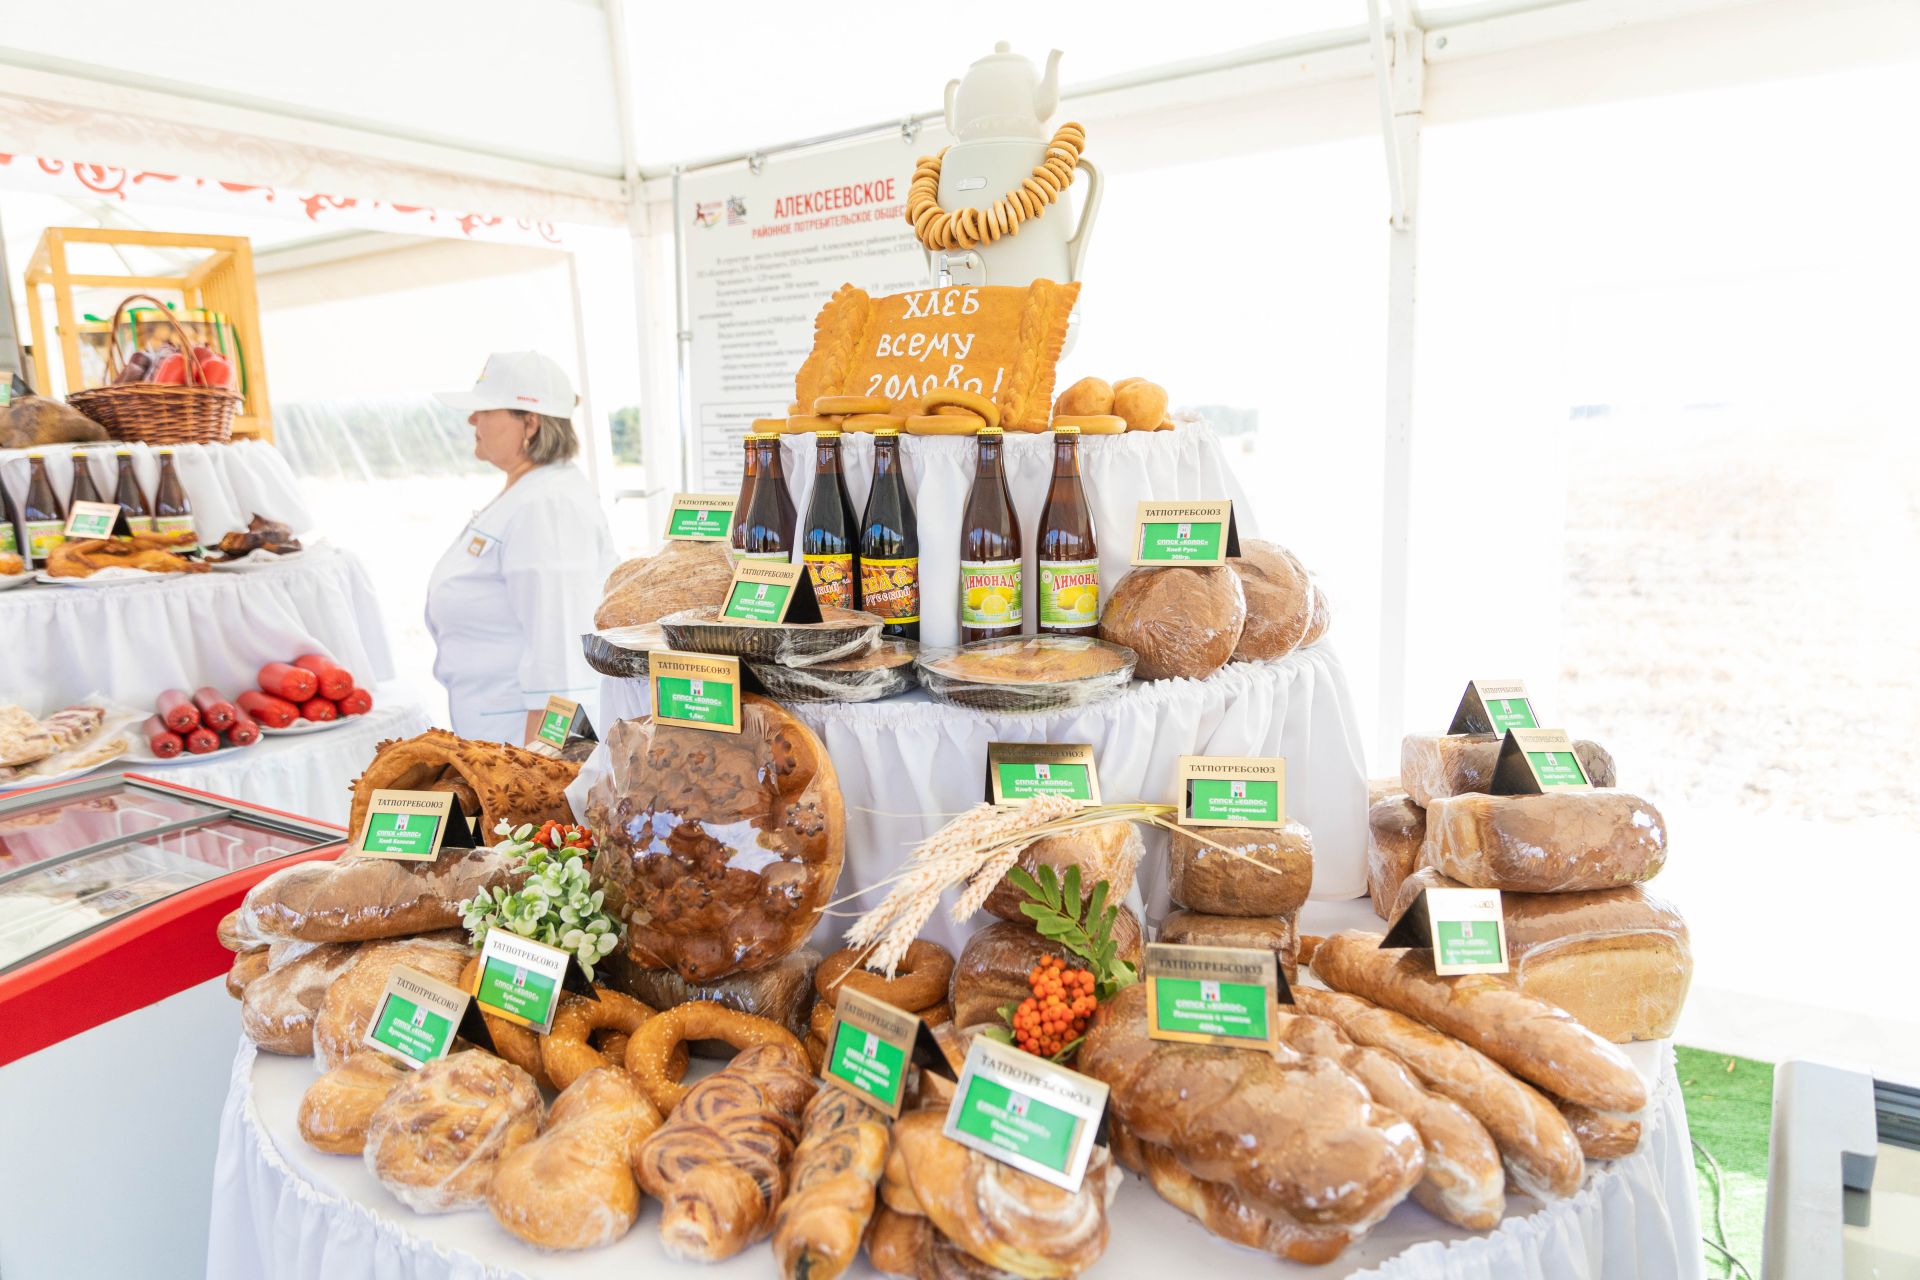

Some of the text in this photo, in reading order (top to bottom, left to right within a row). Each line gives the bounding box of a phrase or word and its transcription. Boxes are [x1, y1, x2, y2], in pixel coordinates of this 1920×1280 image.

[774, 178, 895, 219] АЛЕКСЕЕВСКОЕ
[752, 204, 907, 239] РАЙОННОЕ ПОТРЕБИТЕЛЬСКОЕ ОБЩЕС
[902, 288, 980, 320] ХЛЕБ
[1145, 509, 1221, 517] ТАТПОТРЕБСОЮЗ
[742, 568, 794, 579] ТАТПОТРЕБСОЮЗ
[965, 574, 1015, 591] ЛИМОНАД
[658, 661, 731, 675] ТАТПОТРЕБСОЮЗ
[1189, 764, 1276, 774] ТАТПОТРЕБСОЮЗ
[377, 799, 444, 809] ТАТПОТРЕБСОЮЗ
[493, 941, 560, 970] ТАТПОТРЕБСОЮЗ
[1159, 959, 1264, 975] ТАТПОТРЕБСОЮЗ
[397, 977, 459, 1012] ТАТПОТРЕБСОЮЗ
